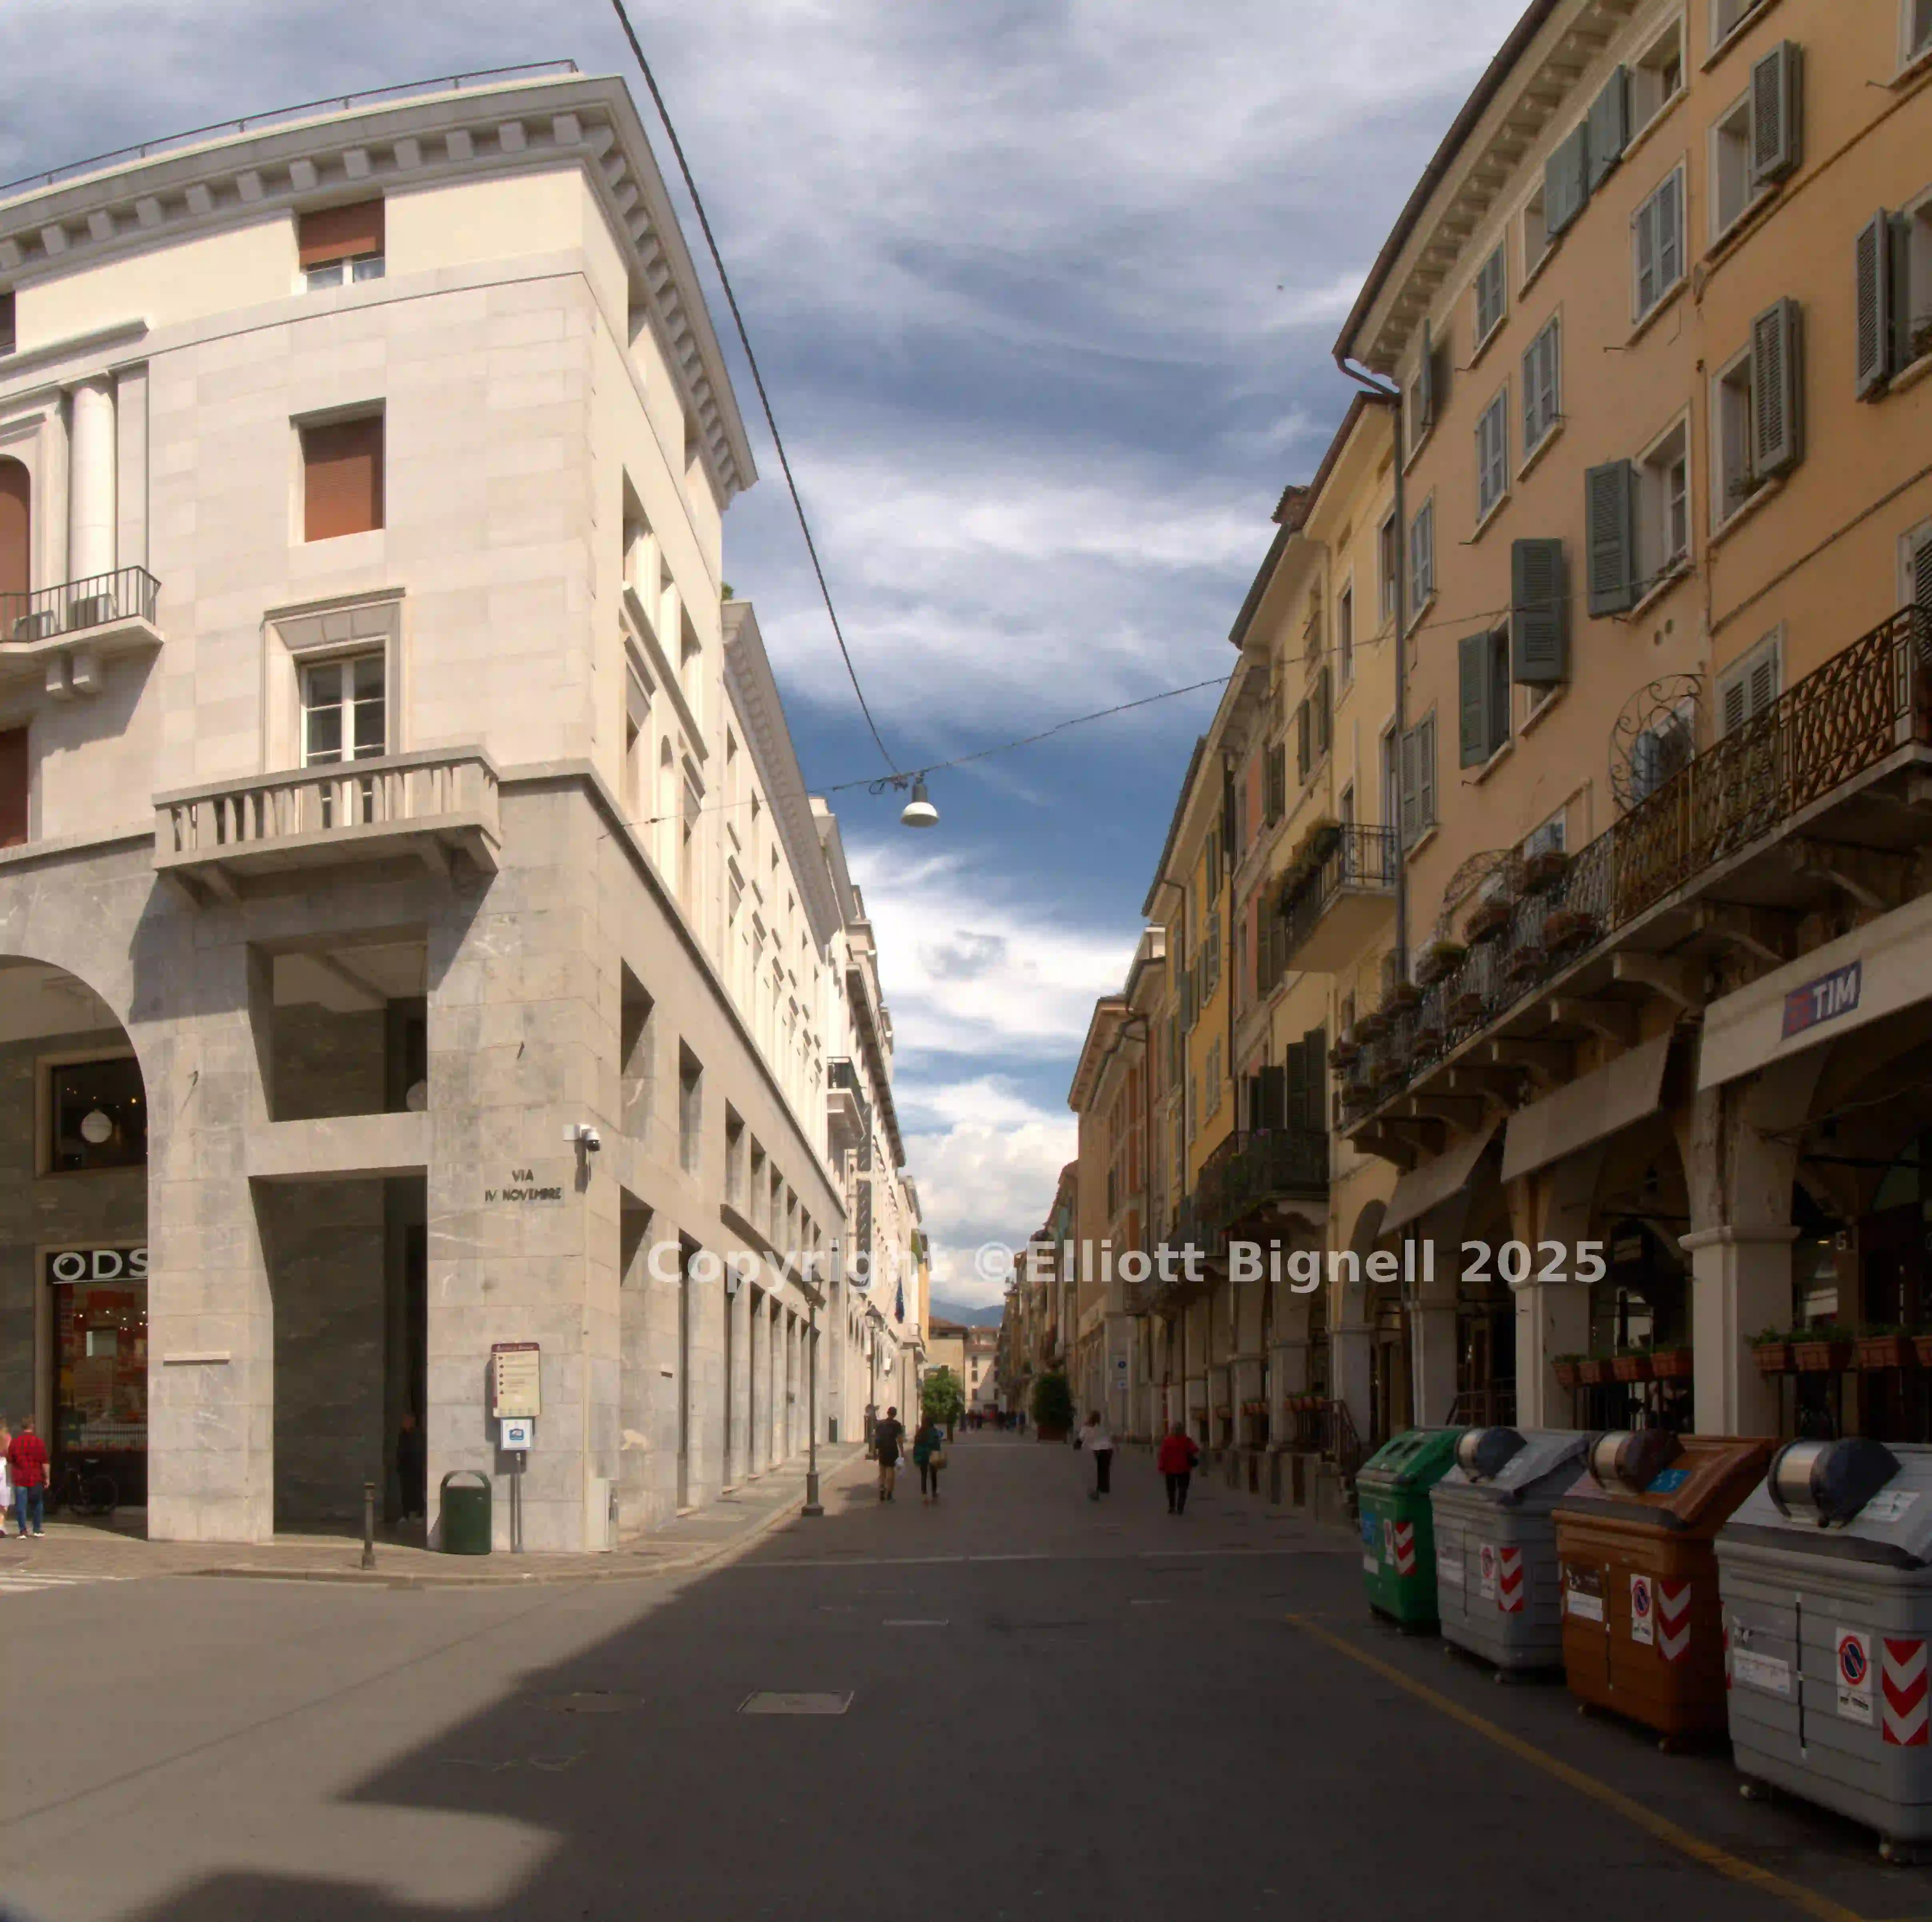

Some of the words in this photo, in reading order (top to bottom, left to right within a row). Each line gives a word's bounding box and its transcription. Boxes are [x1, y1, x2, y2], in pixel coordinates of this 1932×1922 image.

[1813, 970, 1856, 1019] TIM
[511, 1169, 534, 1183] VIA
[485, 1188, 498, 1201] IV
[503, 1187, 561, 1201] NOVEMBRE
